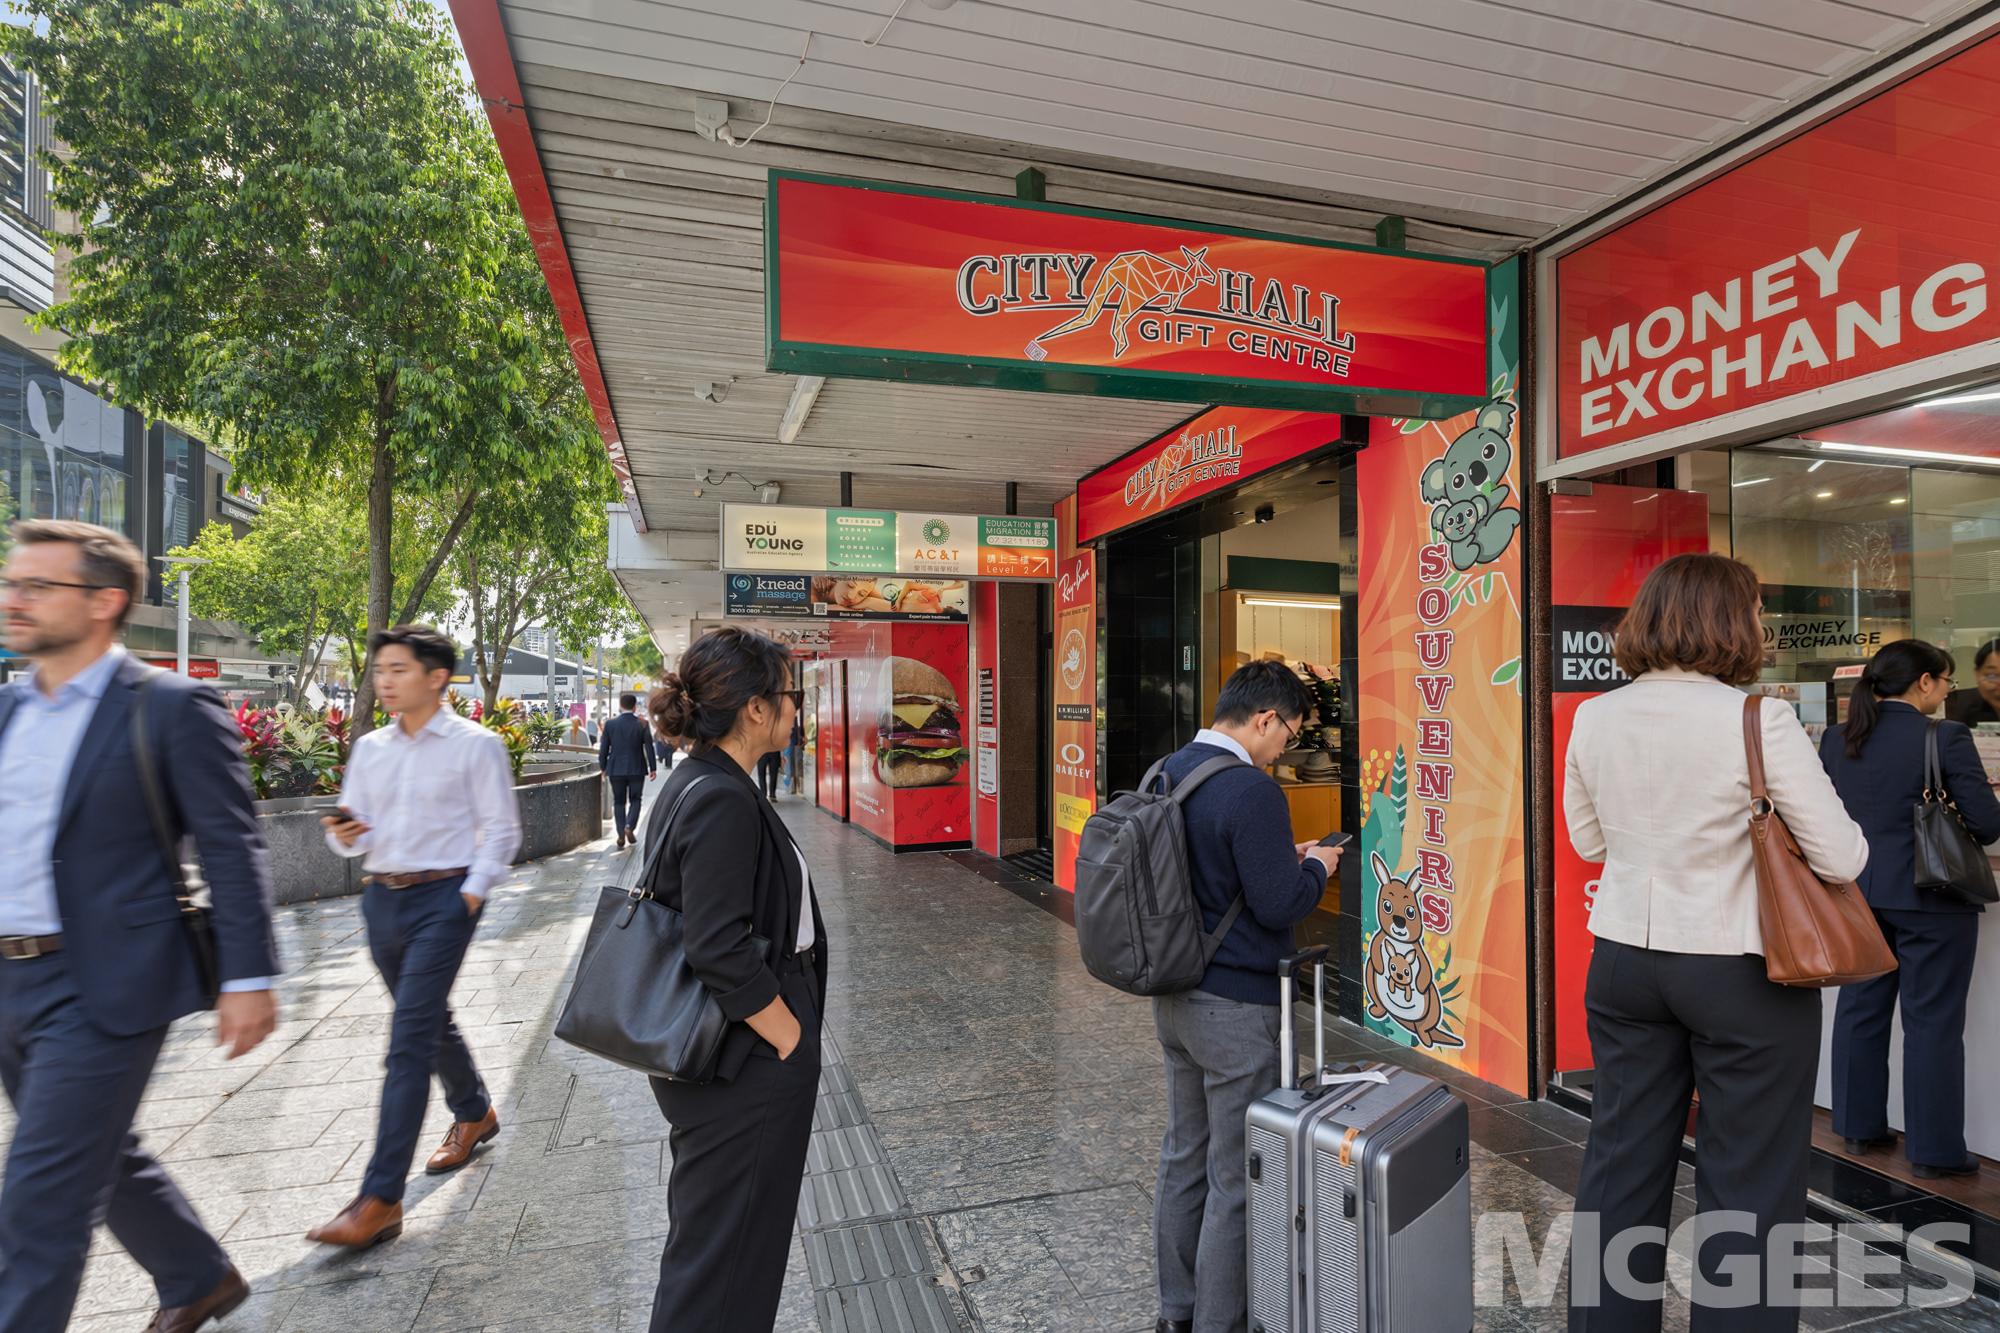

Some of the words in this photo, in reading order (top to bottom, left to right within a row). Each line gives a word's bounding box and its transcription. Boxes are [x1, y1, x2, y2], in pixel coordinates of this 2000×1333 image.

[956, 254, 1098, 316] CITY
[1217, 267, 1356, 354] HALL
[1580, 228, 1862, 383] MONEY
[1138, 319, 1214, 347] GIFT
[1227, 331, 1352, 378] CENTRE
[1580, 262, 1988, 438] EXCHANG
[1125, 458, 1159, 507] CITY
[1191, 425, 1243, 464] HALL
[1168, 474, 1191, 493] GIFT
[1194, 461, 1240, 483] CENTRE
[985, 519, 1031, 528] EDUCATION
[985, 527, 1031, 536] MIGRATION
[745, 537, 804, 551] YOUNG
[914, 549, 959, 561] AC&T
[986, 565, 1014, 574] Level
[1024, 566, 1029, 575] 2
[756, 577, 806, 591] knead
[1058, 559, 1090, 603] Ray-Ban
[756, 590, 806, 601] massage
[1779, 620, 1847, 637] MONEY
[1562, 631, 1618, 654] MON
[1777, 631, 1882, 650] EXCHANGE
[1562, 658, 1633, 681] EXCH
[1416, 542, 1454, 936] SOUVENIRS
[1055, 764, 1091, 779] OAKLEY
